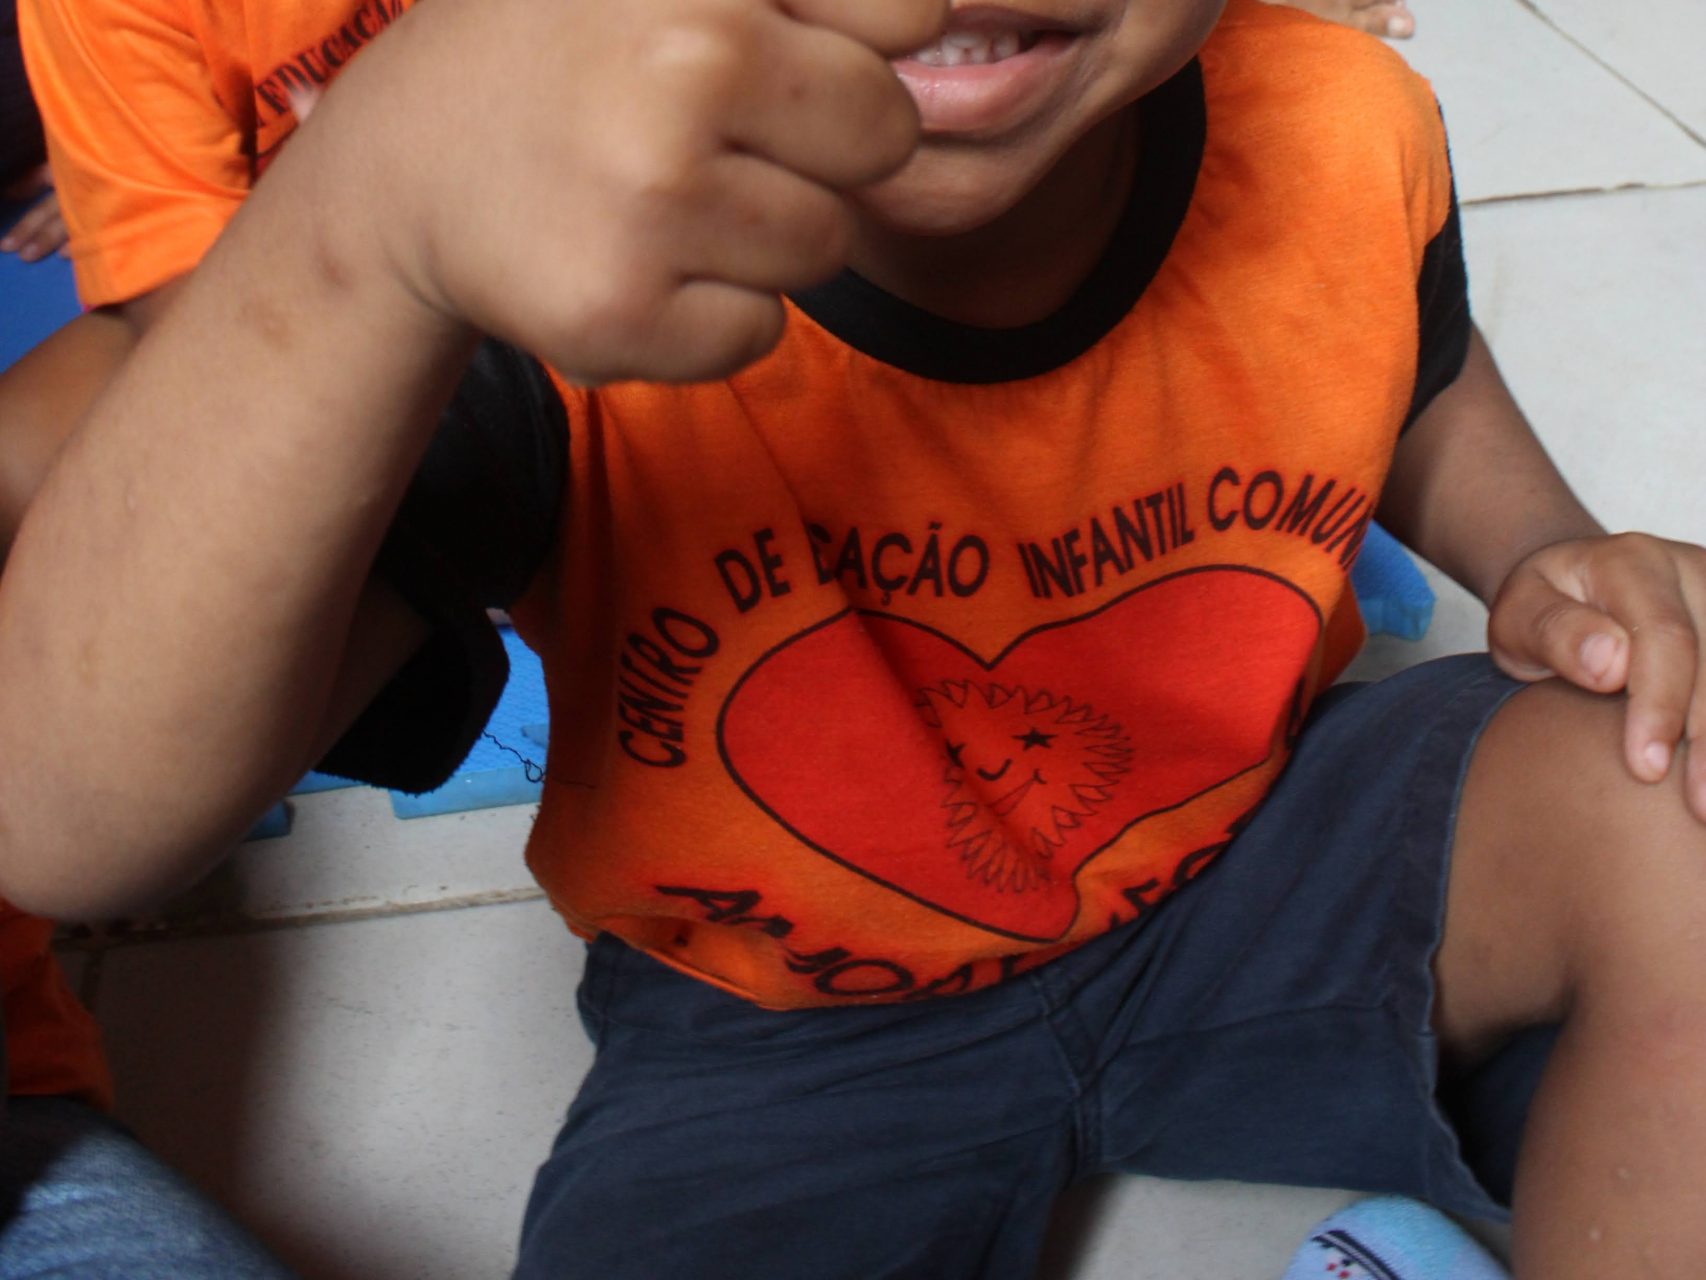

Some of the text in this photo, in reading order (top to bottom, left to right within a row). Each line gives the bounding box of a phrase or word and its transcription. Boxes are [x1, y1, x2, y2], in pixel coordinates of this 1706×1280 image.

[617, 606, 720, 769] CENTRO
[713, 527, 792, 613] DE
[1016, 481, 1196, 599] INFANTIL
